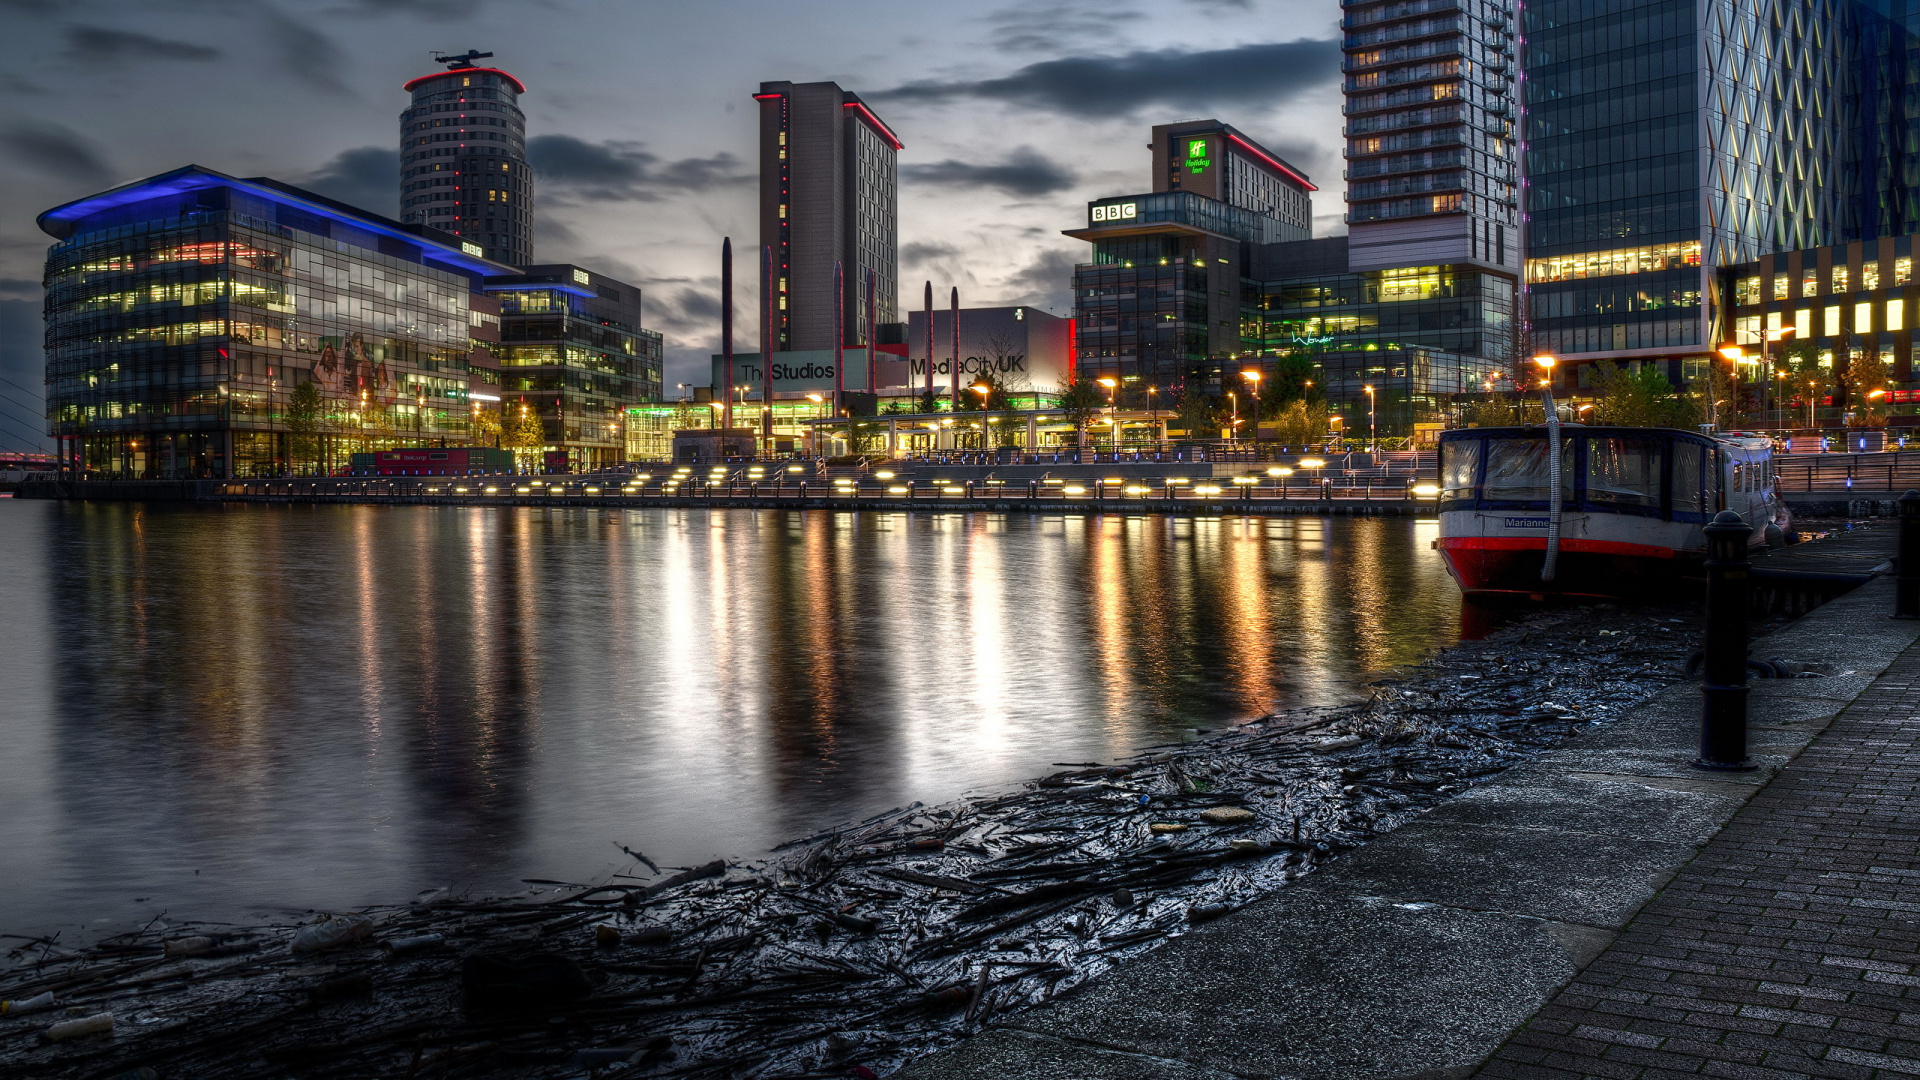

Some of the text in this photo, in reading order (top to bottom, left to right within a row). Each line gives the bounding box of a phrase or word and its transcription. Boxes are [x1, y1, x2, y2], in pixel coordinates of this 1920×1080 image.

[1185, 159, 1210, 167] Holiday
[1094, 204, 1135, 220] BBC
[462, 242, 482, 257] BBC
[574, 269, 588, 285] BBC
[772, 362, 835, 380] Studios
[1505, 519, 1550, 527] Marianne
